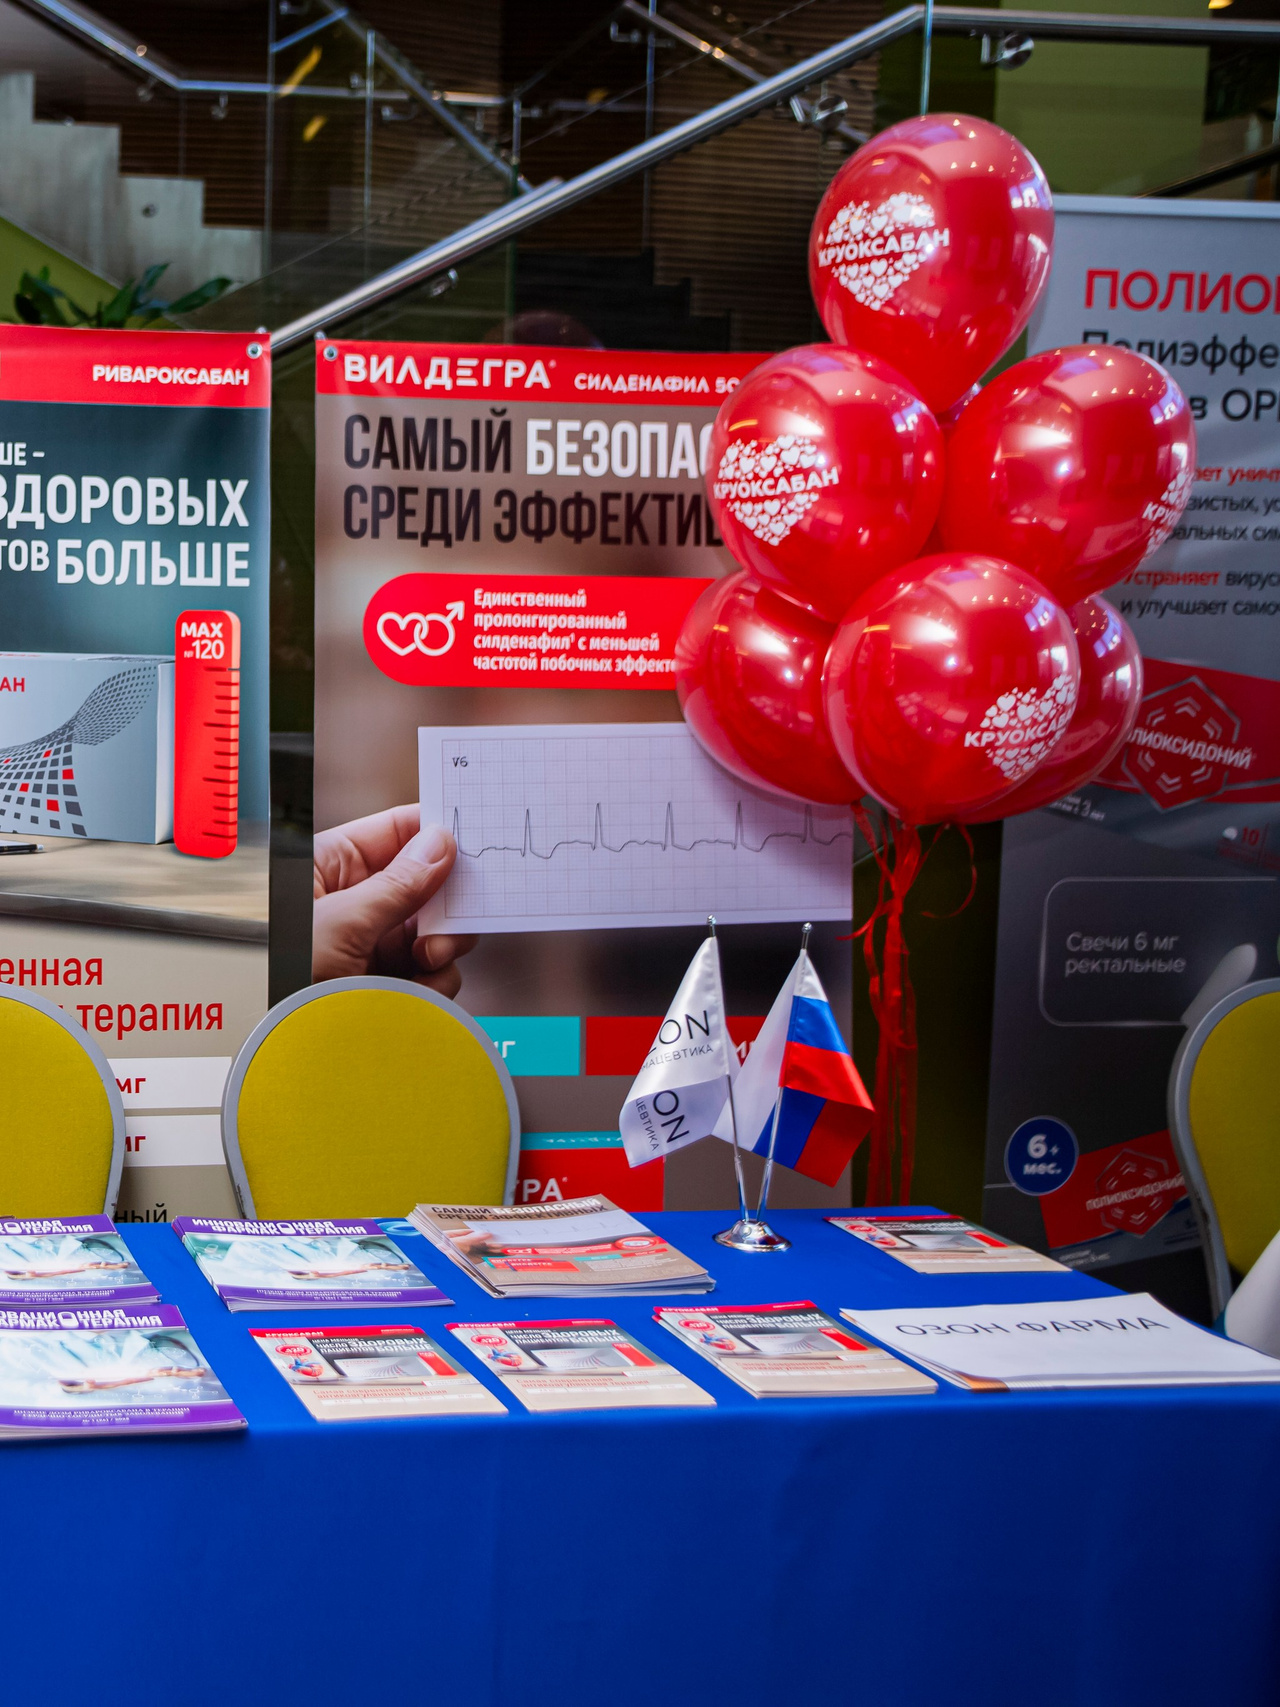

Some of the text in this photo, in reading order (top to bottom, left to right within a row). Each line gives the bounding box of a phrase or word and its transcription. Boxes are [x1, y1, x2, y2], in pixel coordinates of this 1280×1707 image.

[818, 227, 950, 267] КРУОКСАБАН
[1084, 268, 1280, 315] ПОЛИО
[93, 364, 250, 386] РИВАРОКСАБАН
[574, 372, 710, 394] СИЛДЕНАФИЛ
[1222, 387, 1280, 422] ОР
[343, 407, 512, 474] САМЫЙ
[713, 466, 840, 499] КРУОКСАБАН
[343, 484, 481, 549] СРЕДИ
[57, 538, 251, 588] БОЛЬШЕ
[473, 588, 587, 609] Единственный
[181, 622, 223, 639] MAX
[473, 610, 627, 632] пролонгированный
[577, 636, 587, 650] с
[589, 633, 660, 651] меньшей
[473, 652, 538, 671] частотой
[540, 653, 612, 672] побочных
[1128, 727, 1253, 770] ЛИОКСИДОНИЙ
[451, 755, 468, 768] V6
[1066, 931, 1179, 952] Свечи 6 мг
[1065, 957, 1187, 978] ректальные
[77, 1003, 223, 1040] терапия
[647, 1010, 710, 1055] ON
[1027, 1134, 1060, 1159] 6+
[492, 1197, 602, 1215] БЕЗОПАСНЫЙ
[895, 1316, 1171, 1336] ОЗОН ФАРМА
